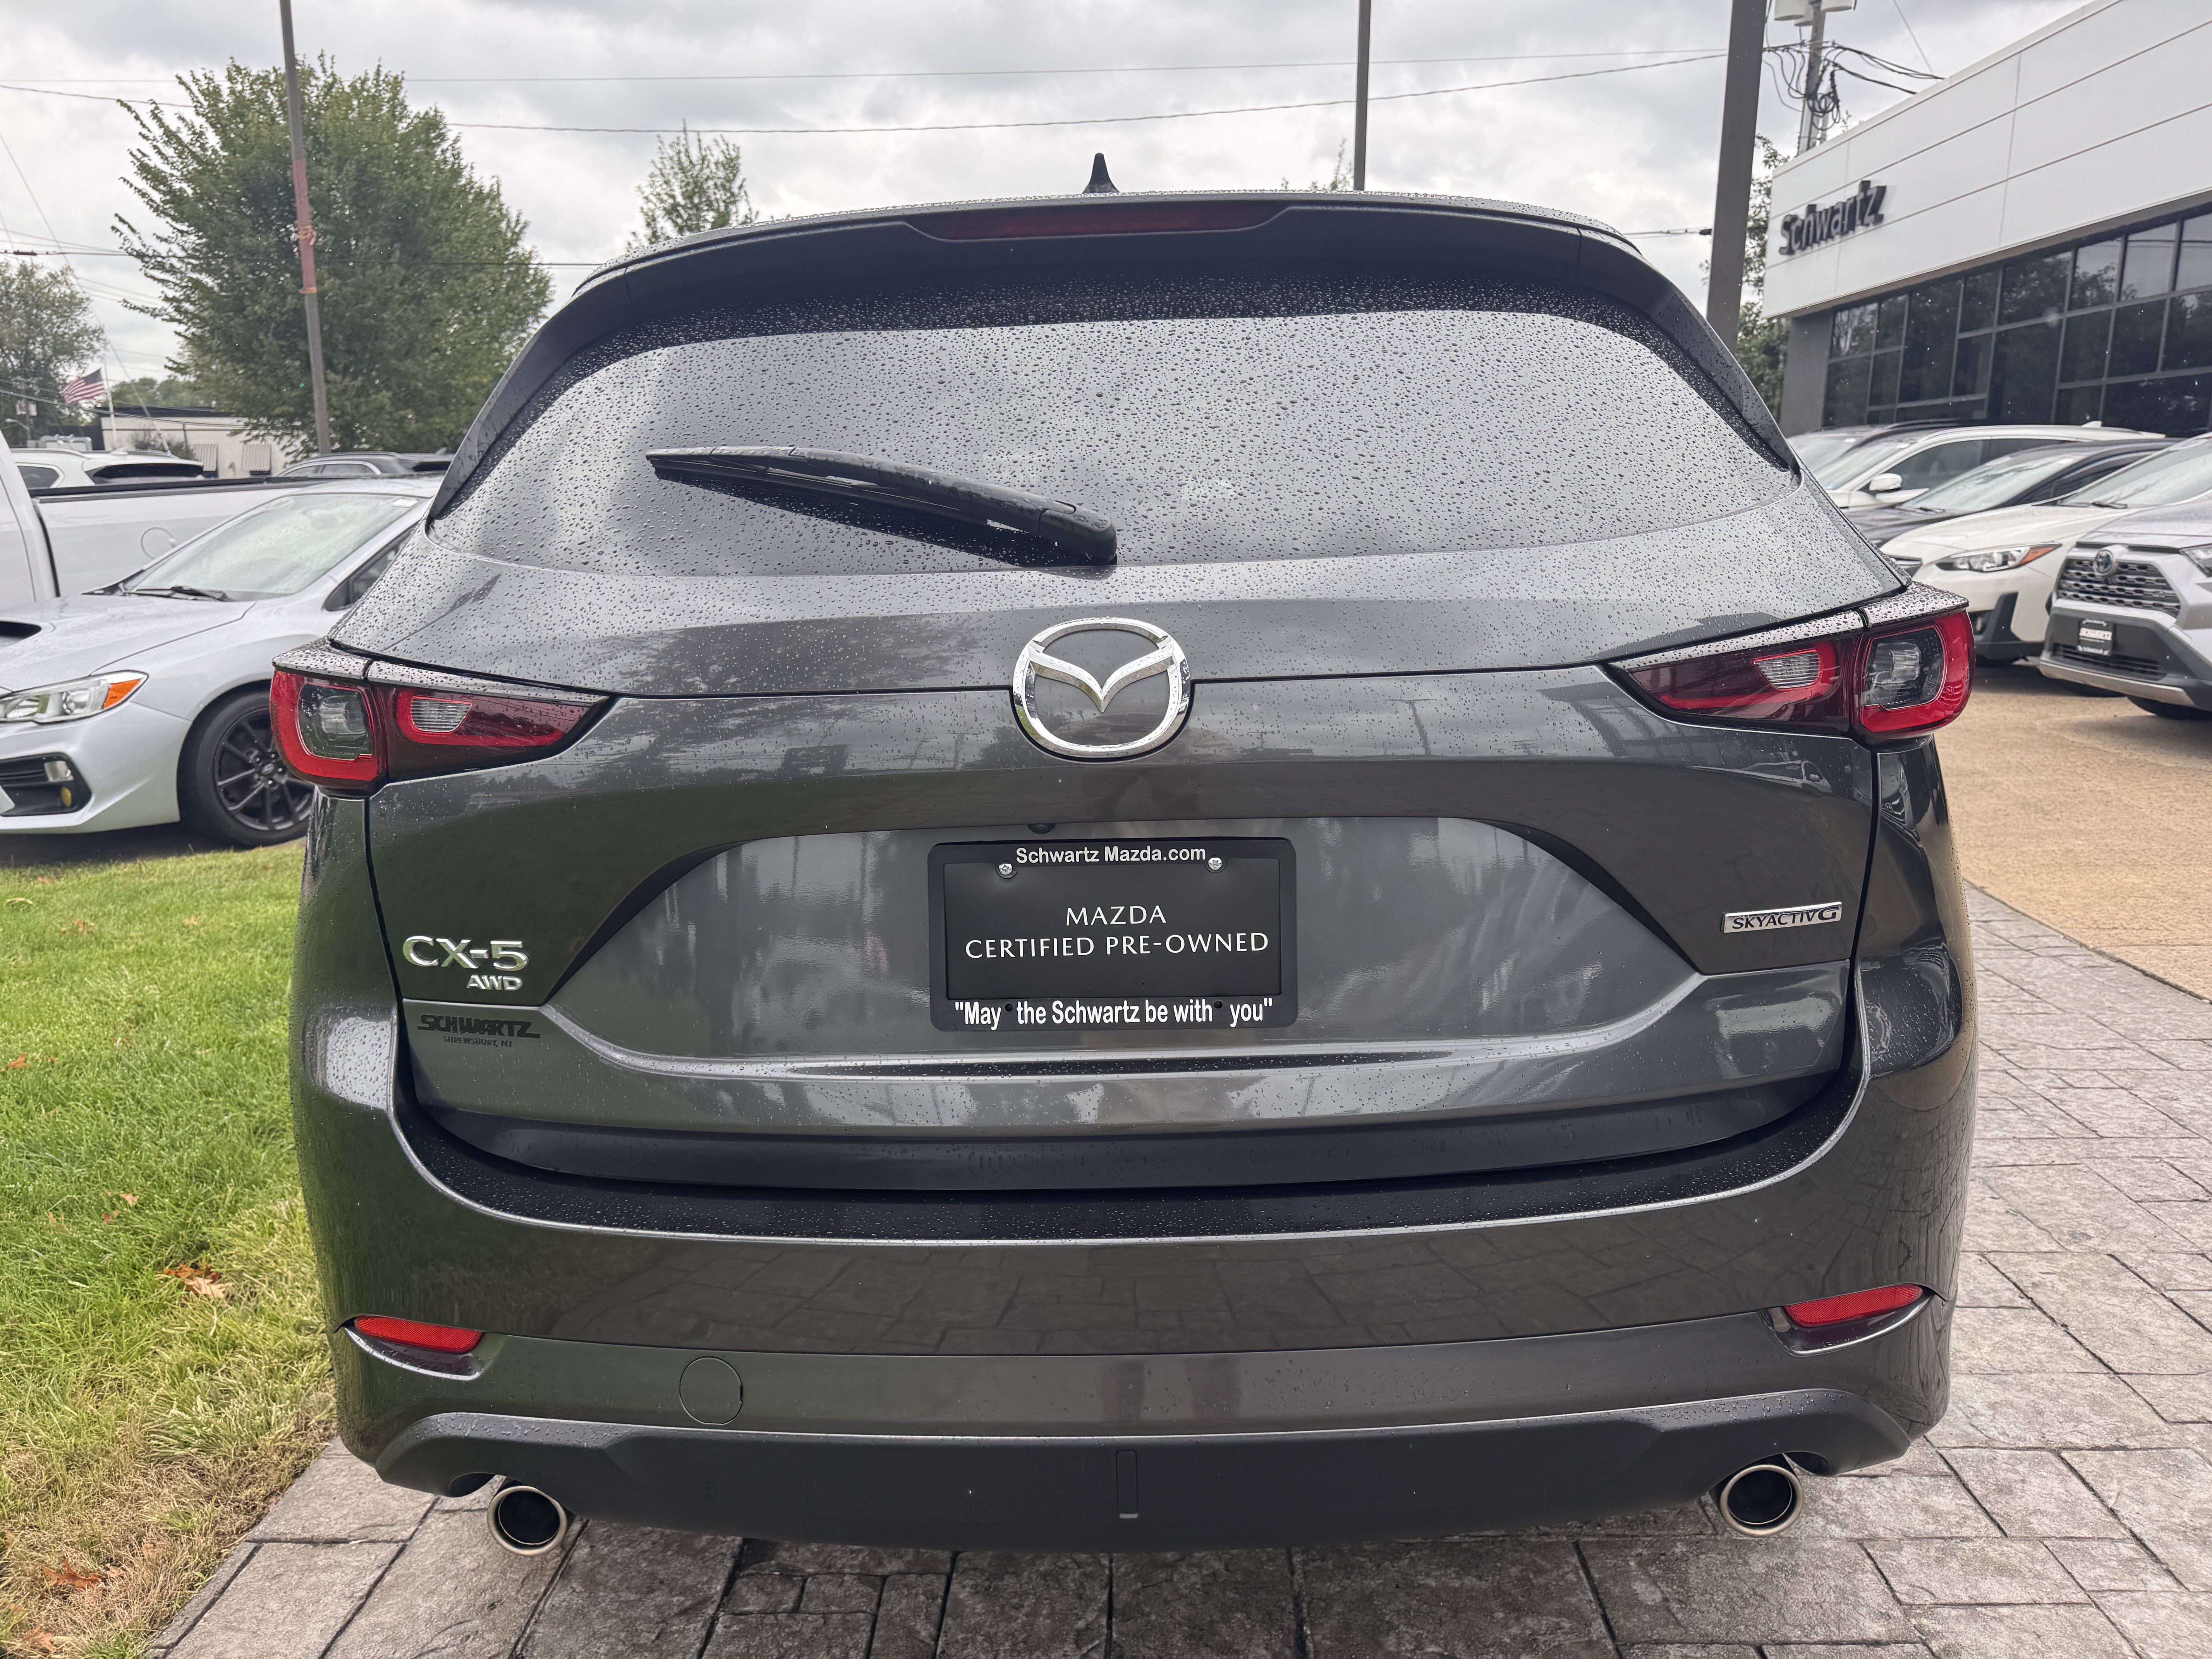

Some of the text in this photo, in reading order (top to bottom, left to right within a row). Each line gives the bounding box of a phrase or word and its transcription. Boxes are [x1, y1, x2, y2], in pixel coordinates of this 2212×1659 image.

[1779, 180, 1887, 255] Schwartz
[1016, 845, 1206, 864] Schwartz Mazda.com
[1066, 905, 1166, 926] MAZDA
[402, 935, 529, 971] CX-5
[965, 933, 1268, 958] CERTIFIED PRE-OWNED
[466, 974, 524, 991] AWD
[417, 1014, 541, 1039] SCHWARTZ
[955, 998, 1273, 1030] "May the Schwartz be with you"
[443, 1036, 498, 1048] SHREWSBURY,
